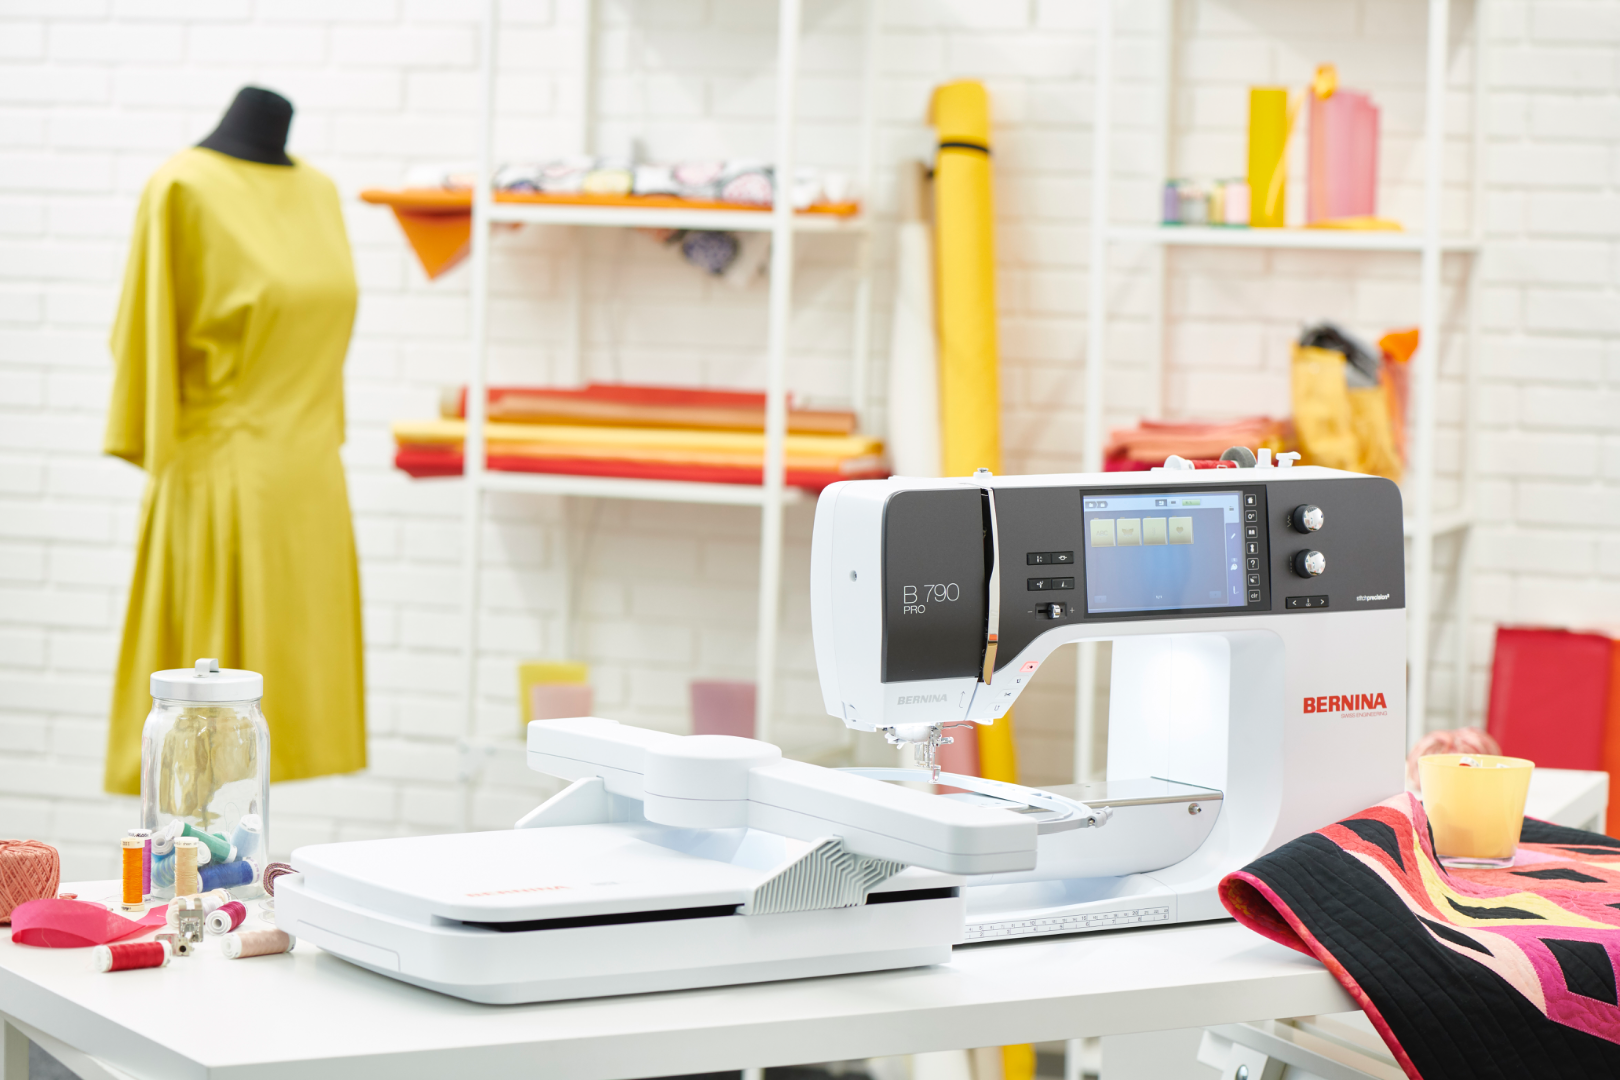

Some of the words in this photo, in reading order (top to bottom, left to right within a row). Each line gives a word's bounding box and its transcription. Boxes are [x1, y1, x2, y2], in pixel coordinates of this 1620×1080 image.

[903, 585, 918, 604] B
[924, 583, 959, 602] 790
[903, 604, 926, 615] PRO
[897, 693, 948, 706] BERNINA
[1303, 693, 1387, 714] BERNINA
[1355, 710, 1388, 718] ENGINEERING
